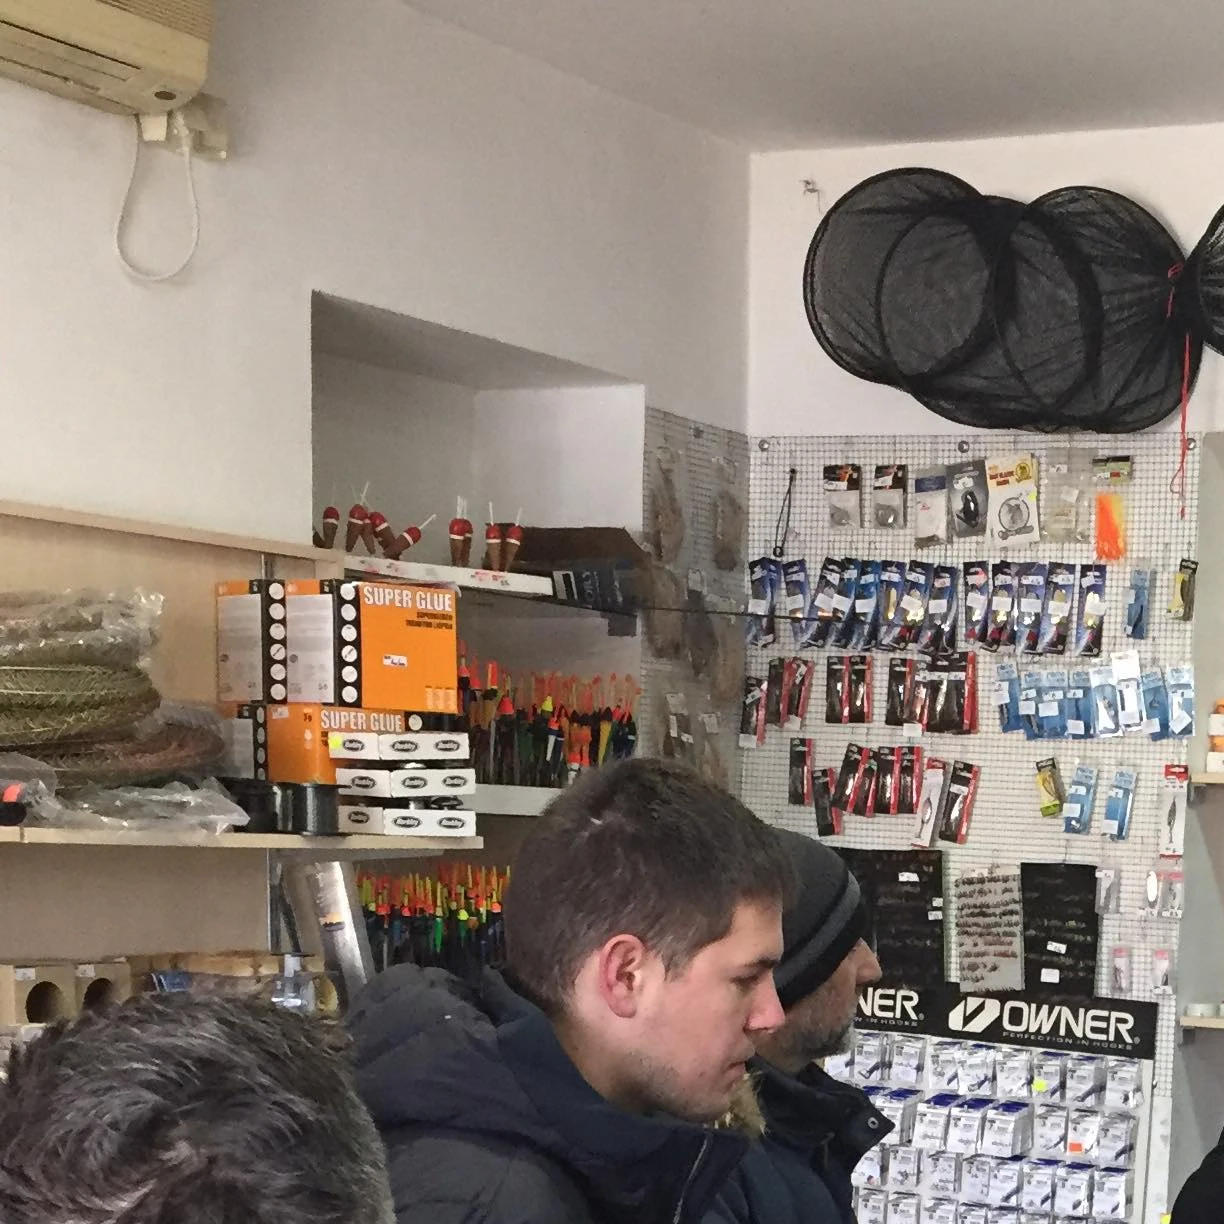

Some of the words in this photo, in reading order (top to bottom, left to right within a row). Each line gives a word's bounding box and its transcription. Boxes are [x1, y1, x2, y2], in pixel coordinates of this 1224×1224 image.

[364, 586, 412, 608] SUPER
[416, 591, 453, 612] GLUE
[320, 710, 366, 730] SUPER
[370, 712, 402, 732] GLUE
[858, 987, 918, 1020] NER
[1002, 1001, 1134, 1044] OWNER
